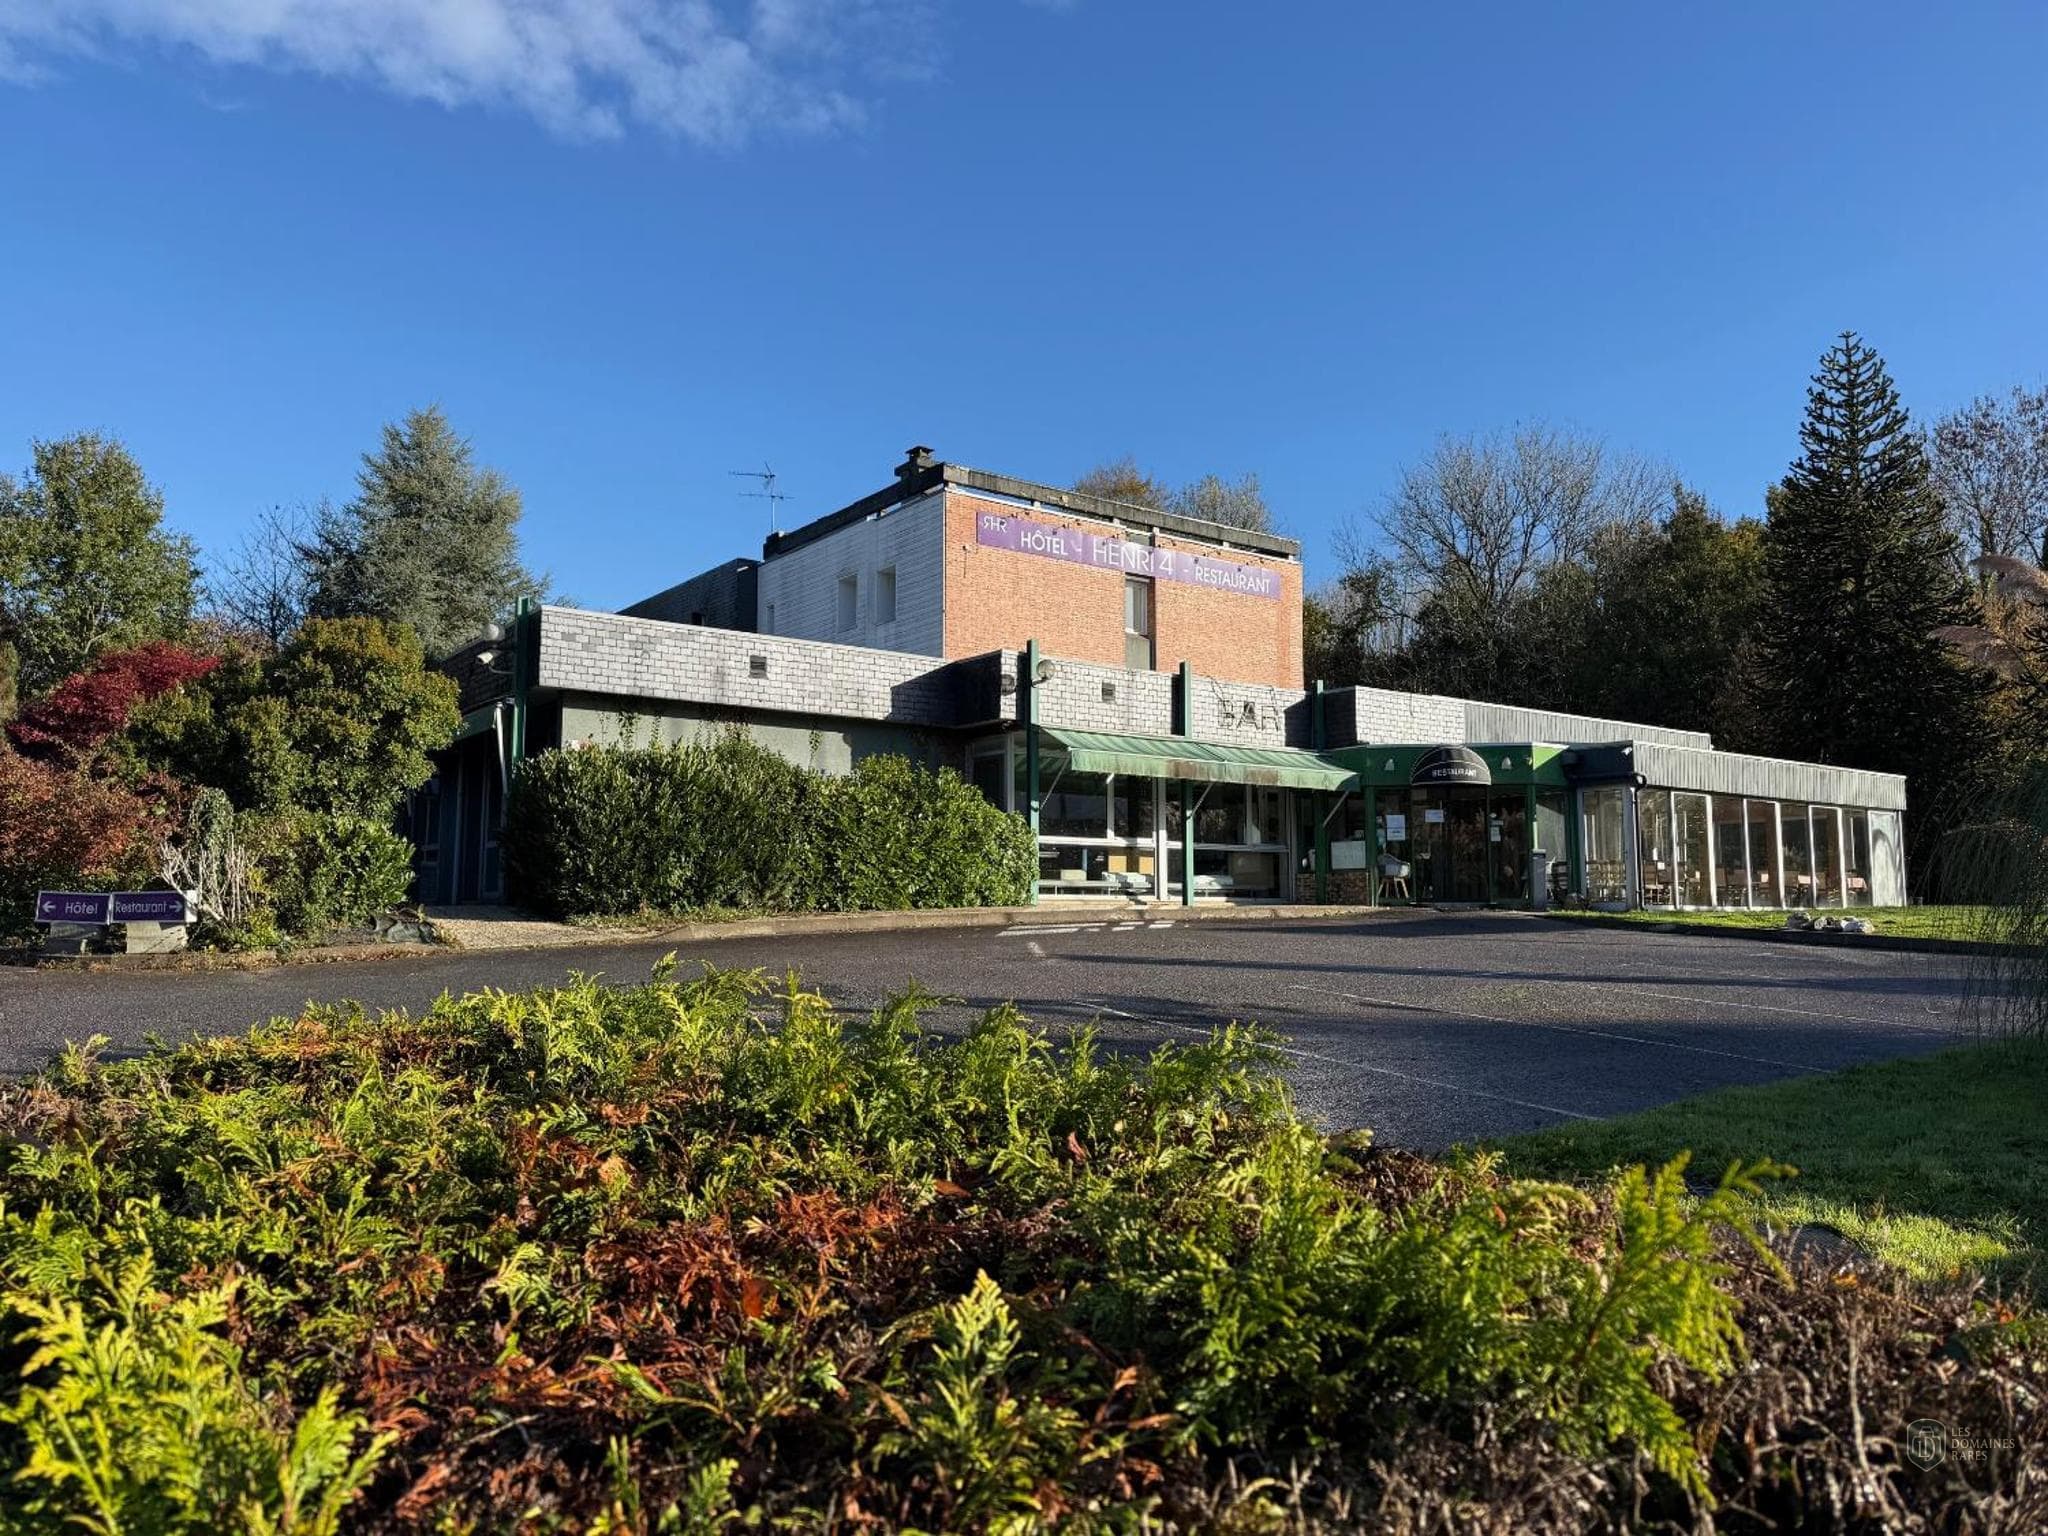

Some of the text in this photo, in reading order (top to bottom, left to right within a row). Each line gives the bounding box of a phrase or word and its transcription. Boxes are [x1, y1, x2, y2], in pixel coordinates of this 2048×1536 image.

[1020, 530, 1069, 556] HÔTEL
[1093, 538, 1154, 573] HENRI
[1159, 548, 1174, 576] 4
[1195, 566, 1271, 594] RESTAURANT
[1432, 768, 1477, 777] RESTAURANT
[65, 901, 98, 914] Hôtel
[115, 901, 167, 913] Restaurant
